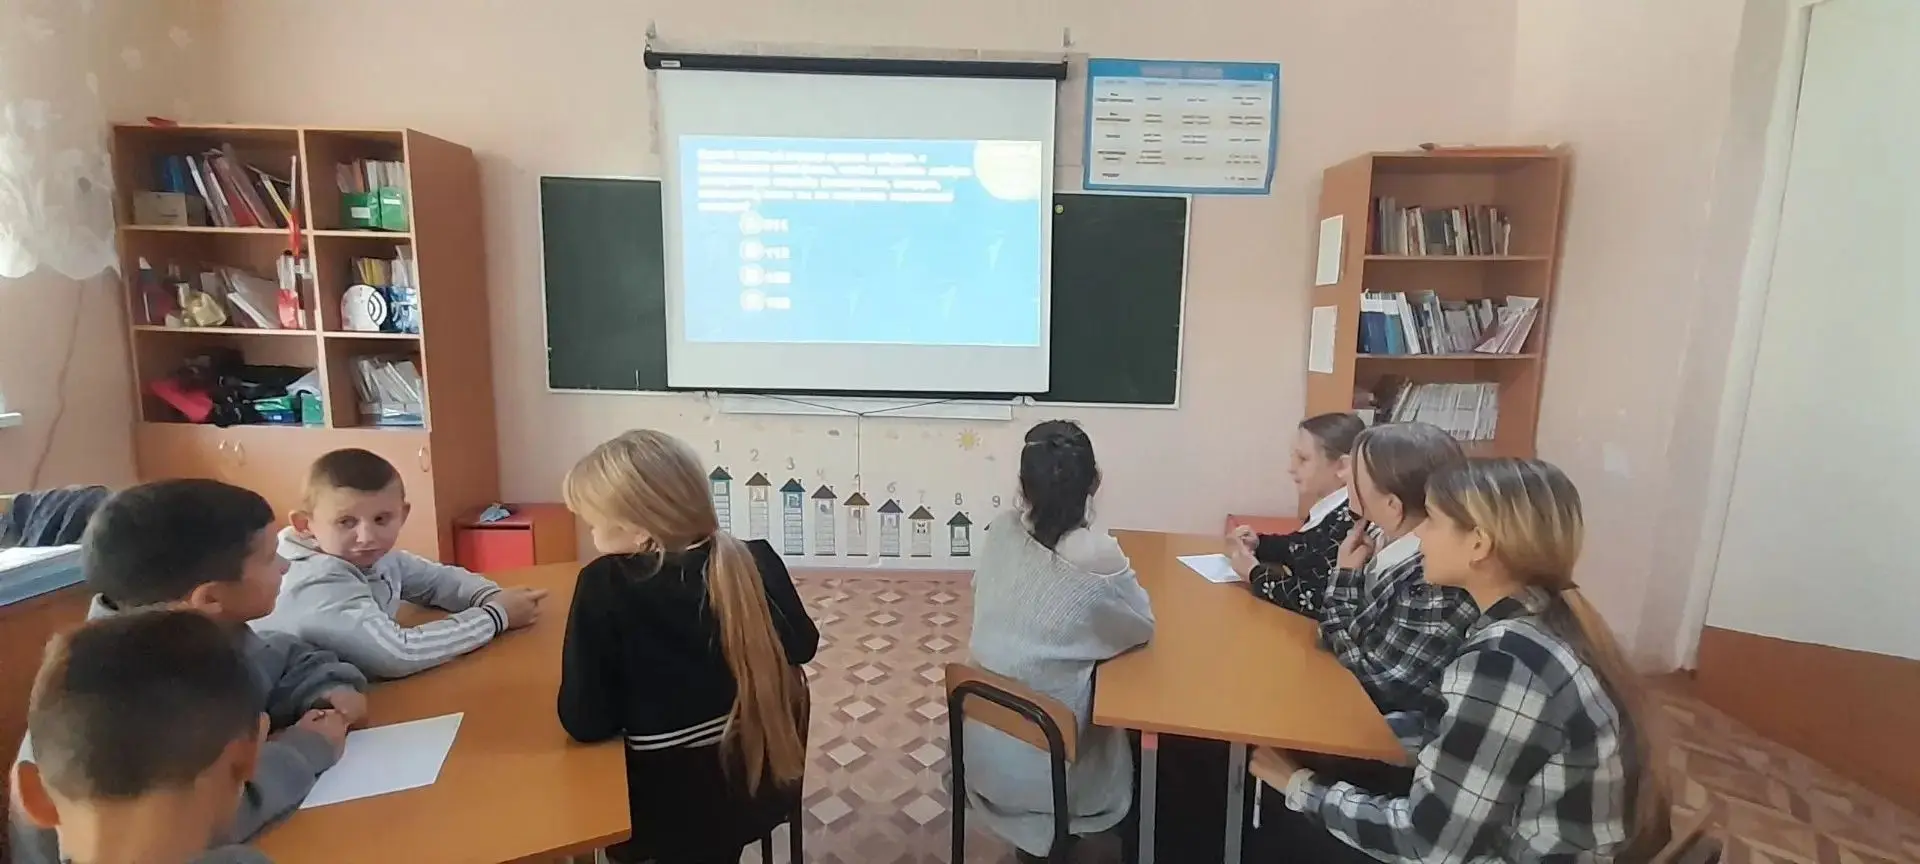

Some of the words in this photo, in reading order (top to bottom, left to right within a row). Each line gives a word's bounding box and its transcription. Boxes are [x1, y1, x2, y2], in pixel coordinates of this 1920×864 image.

[714, 439, 721, 453] 1
[749, 448, 759, 462] 2
[786, 456, 795, 470] 3
[886, 481, 897, 494] 6
[954, 492, 963, 505] 8
[991, 495, 1001, 508] 9
